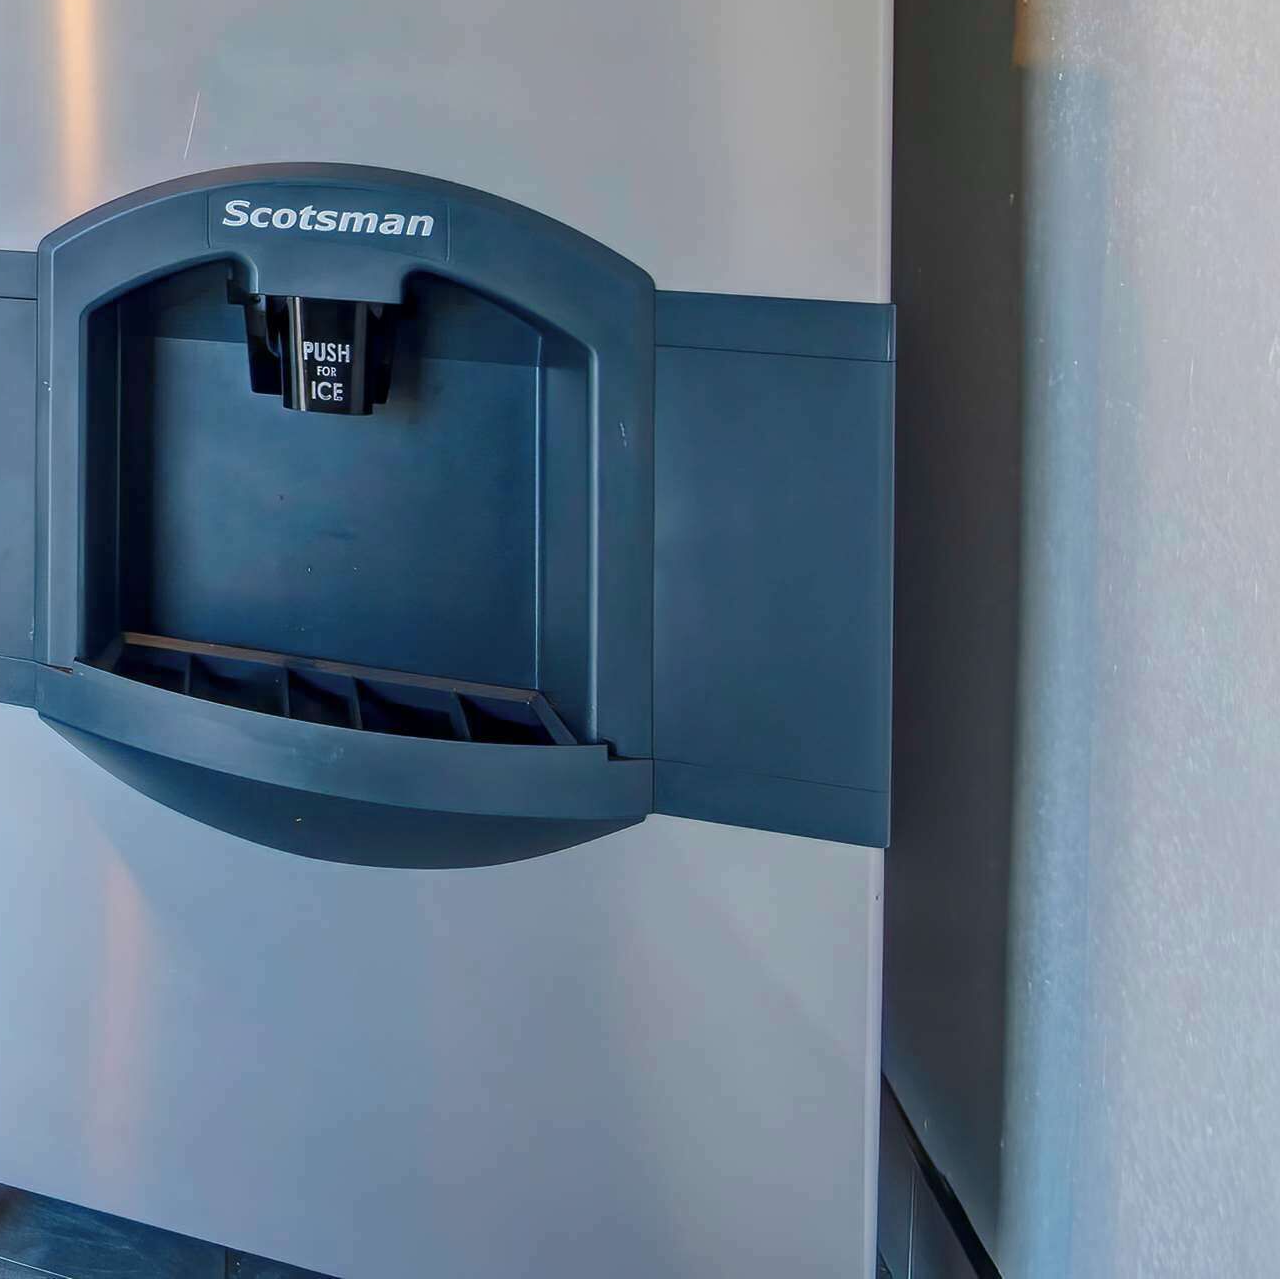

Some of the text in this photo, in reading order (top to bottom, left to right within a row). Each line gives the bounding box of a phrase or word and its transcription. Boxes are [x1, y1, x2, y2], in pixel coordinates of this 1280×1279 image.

[222, 200, 434, 237] Scotsman
[303, 341, 351, 364] PUSH
[317, 366, 337, 377] FOR
[311, 381, 343, 402] ICE
